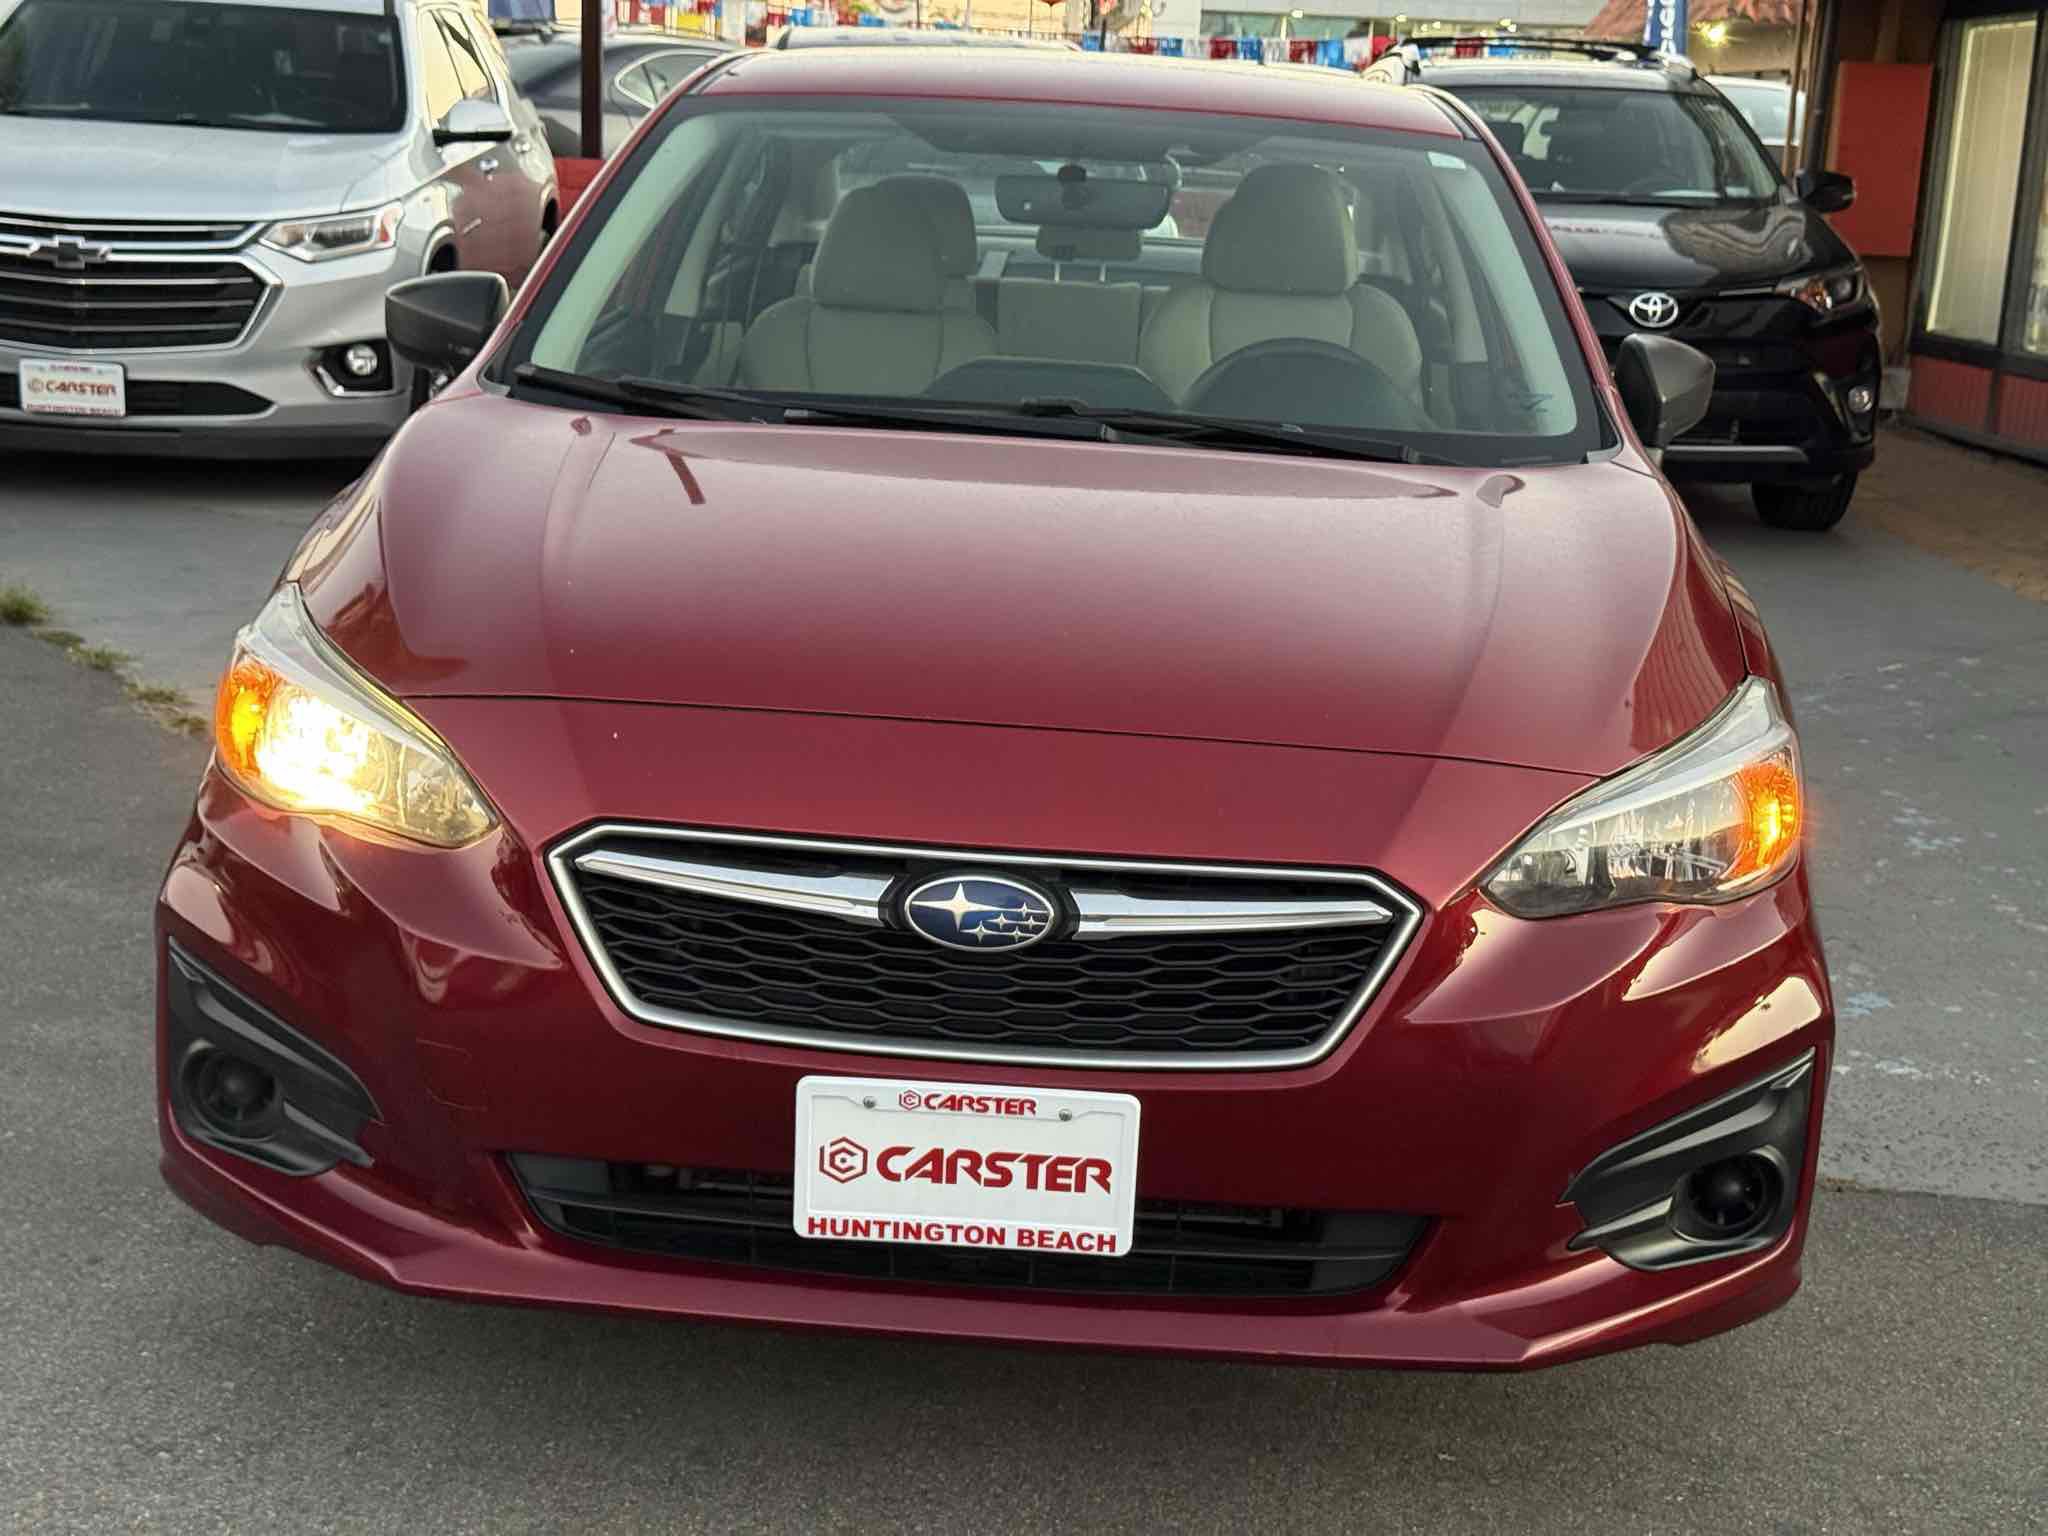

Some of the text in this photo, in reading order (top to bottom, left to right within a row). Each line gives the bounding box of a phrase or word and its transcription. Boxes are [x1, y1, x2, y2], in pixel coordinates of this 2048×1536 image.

[46, 379, 116, 395] CARSTER
[924, 1093, 1036, 1115] CARSTER
[876, 1146, 1112, 1194] CARSTER
[808, 1216, 1116, 1252] HUNTINGTON BEACH
